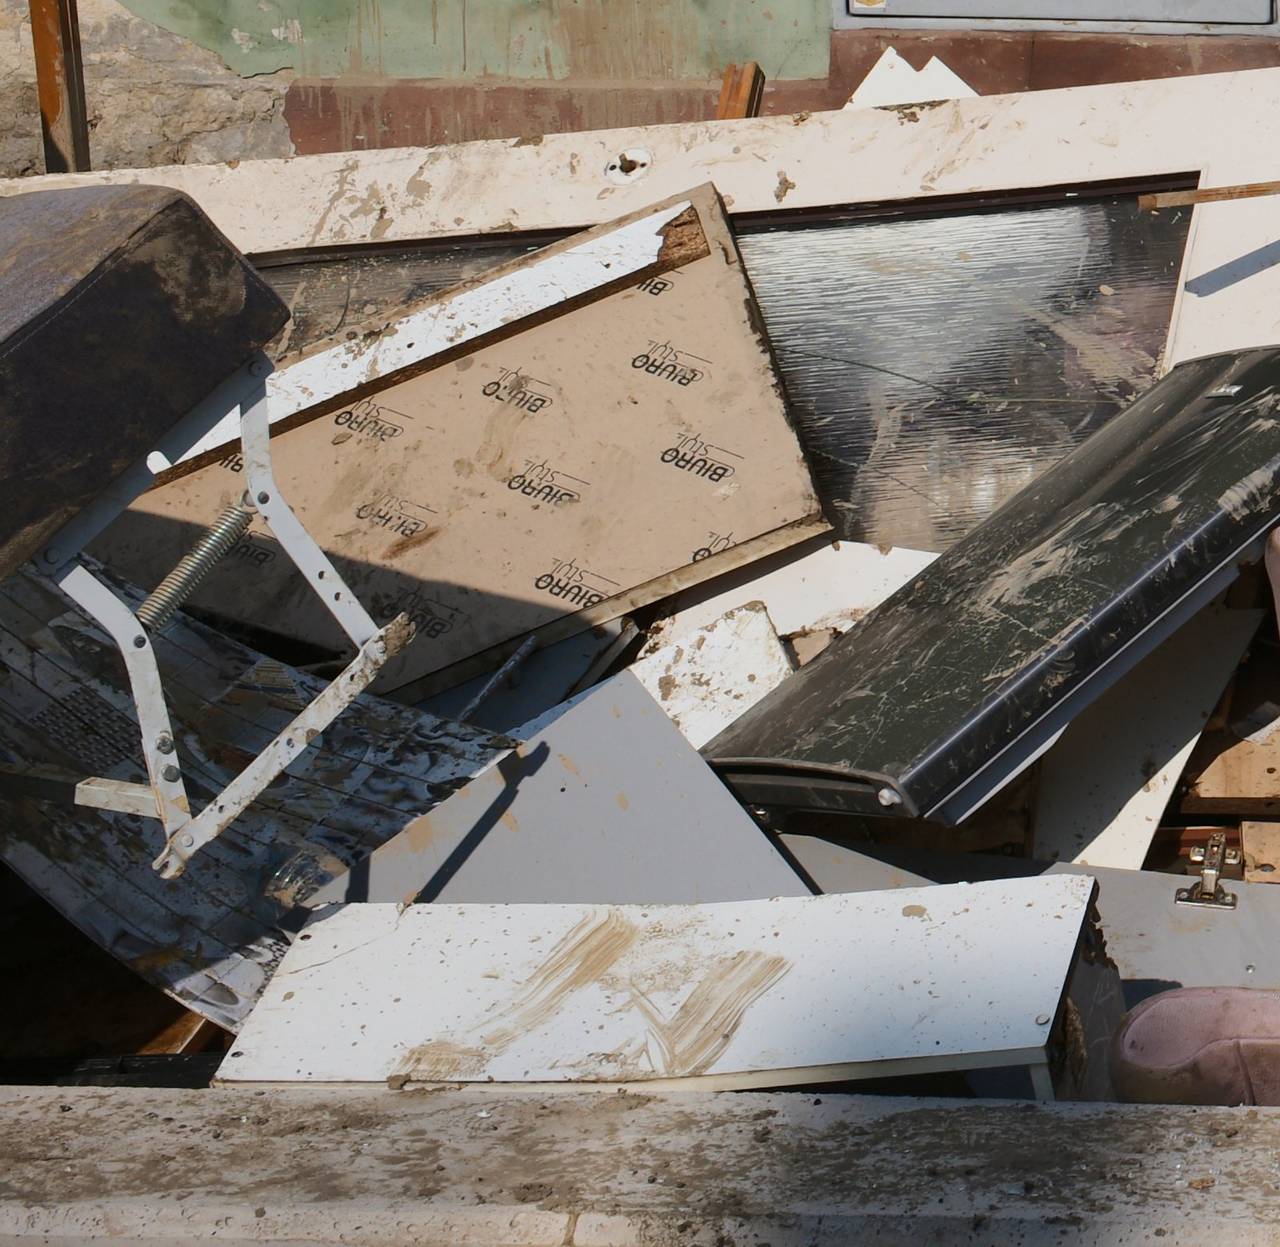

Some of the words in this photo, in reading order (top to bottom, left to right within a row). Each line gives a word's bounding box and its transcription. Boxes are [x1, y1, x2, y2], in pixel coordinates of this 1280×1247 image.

[631, 354, 699, 387] BIURO
[661, 447, 729, 483] BIURO
[535, 573, 605, 608] BIURO
